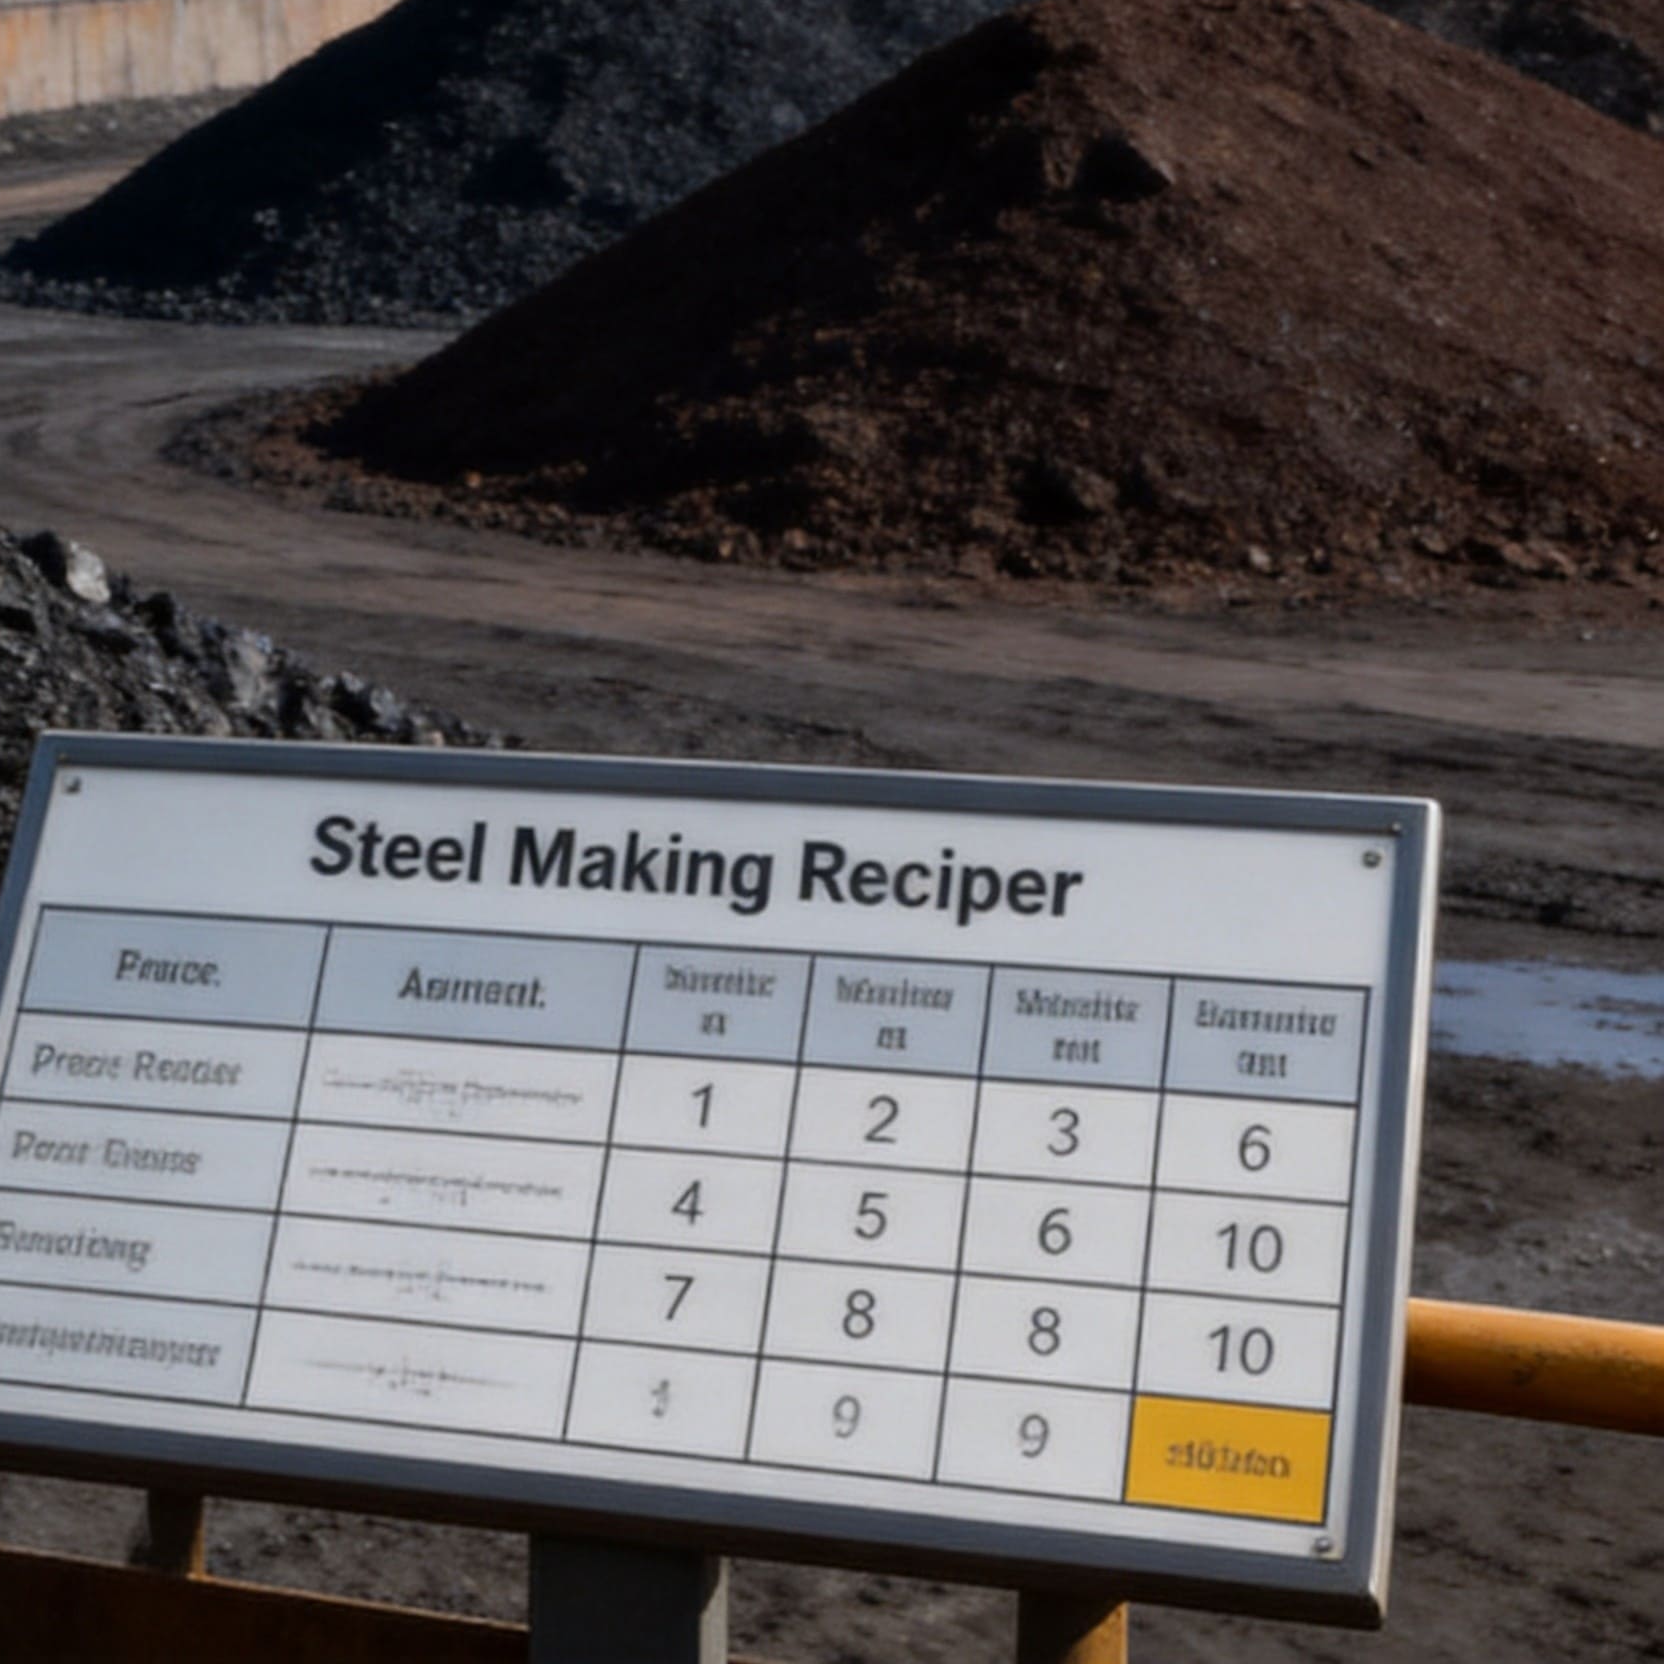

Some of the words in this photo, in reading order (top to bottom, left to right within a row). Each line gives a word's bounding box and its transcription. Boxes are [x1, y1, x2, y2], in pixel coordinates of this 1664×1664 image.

[308, 813, 489, 885] Steel
[507, 824, 775, 917] Making
[796, 839, 1085, 929] Reciper
[691, 1082, 714, 1129] 1
[863, 1094, 900, 1144] 2
[1047, 1107, 1081, 1157] 3
[1237, 1123, 1271, 1173] 6
[670, 1179, 704, 1225] 4
[854, 1191, 889, 1241] 5
[1037, 1207, 1073, 1256] 6
[1217, 1222, 1284, 1274] 10
[663, 1273, 695, 1321] 7
[841, 1288, 877, 1340] 8
[1027, 1306, 1062, 1357] 8
[1208, 1324, 1275, 1377] 10
[831, 1394, 863, 1440] 9
[1017, 1412, 1051, 1460] 9
